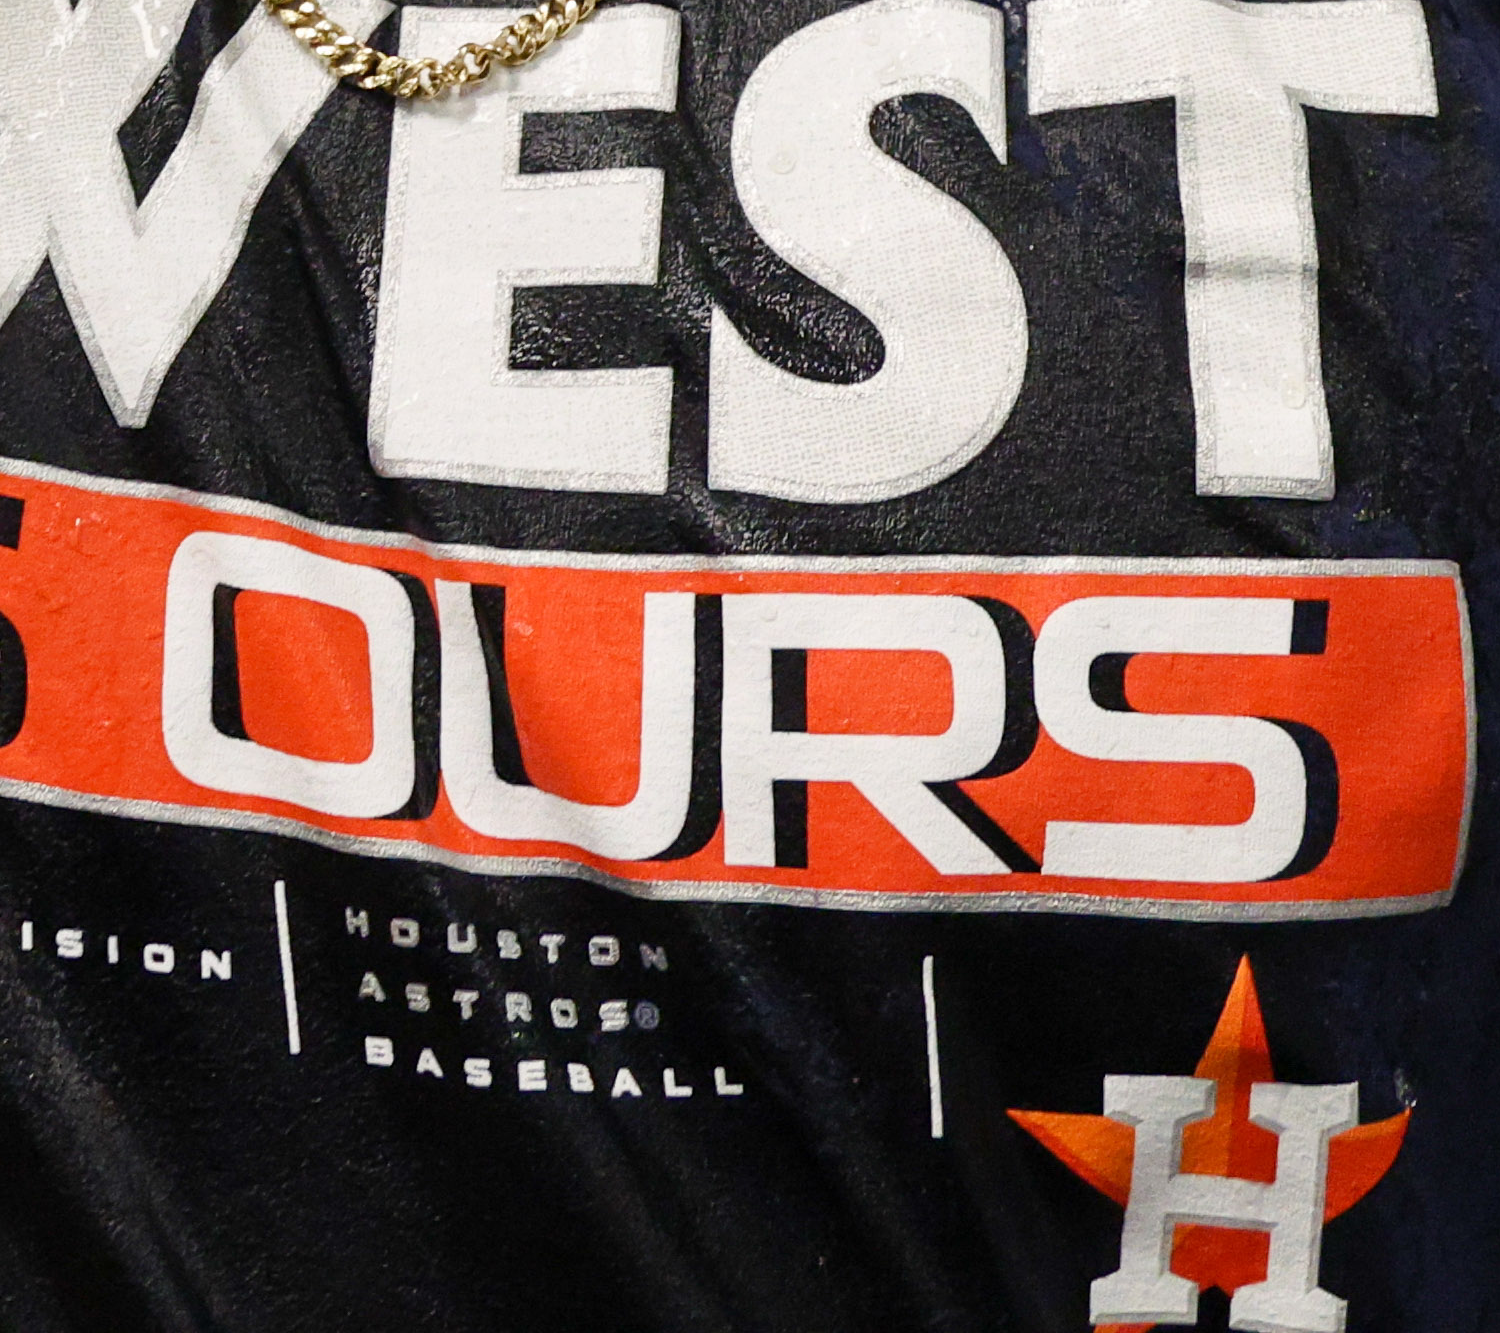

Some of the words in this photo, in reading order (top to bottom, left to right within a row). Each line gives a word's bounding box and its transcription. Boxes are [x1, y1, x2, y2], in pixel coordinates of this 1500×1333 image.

[160, 533, 1328, 883] OURS
[346, 906, 669, 975] HOUSTON
[365, 1034, 745, 1098] BASEBALL
